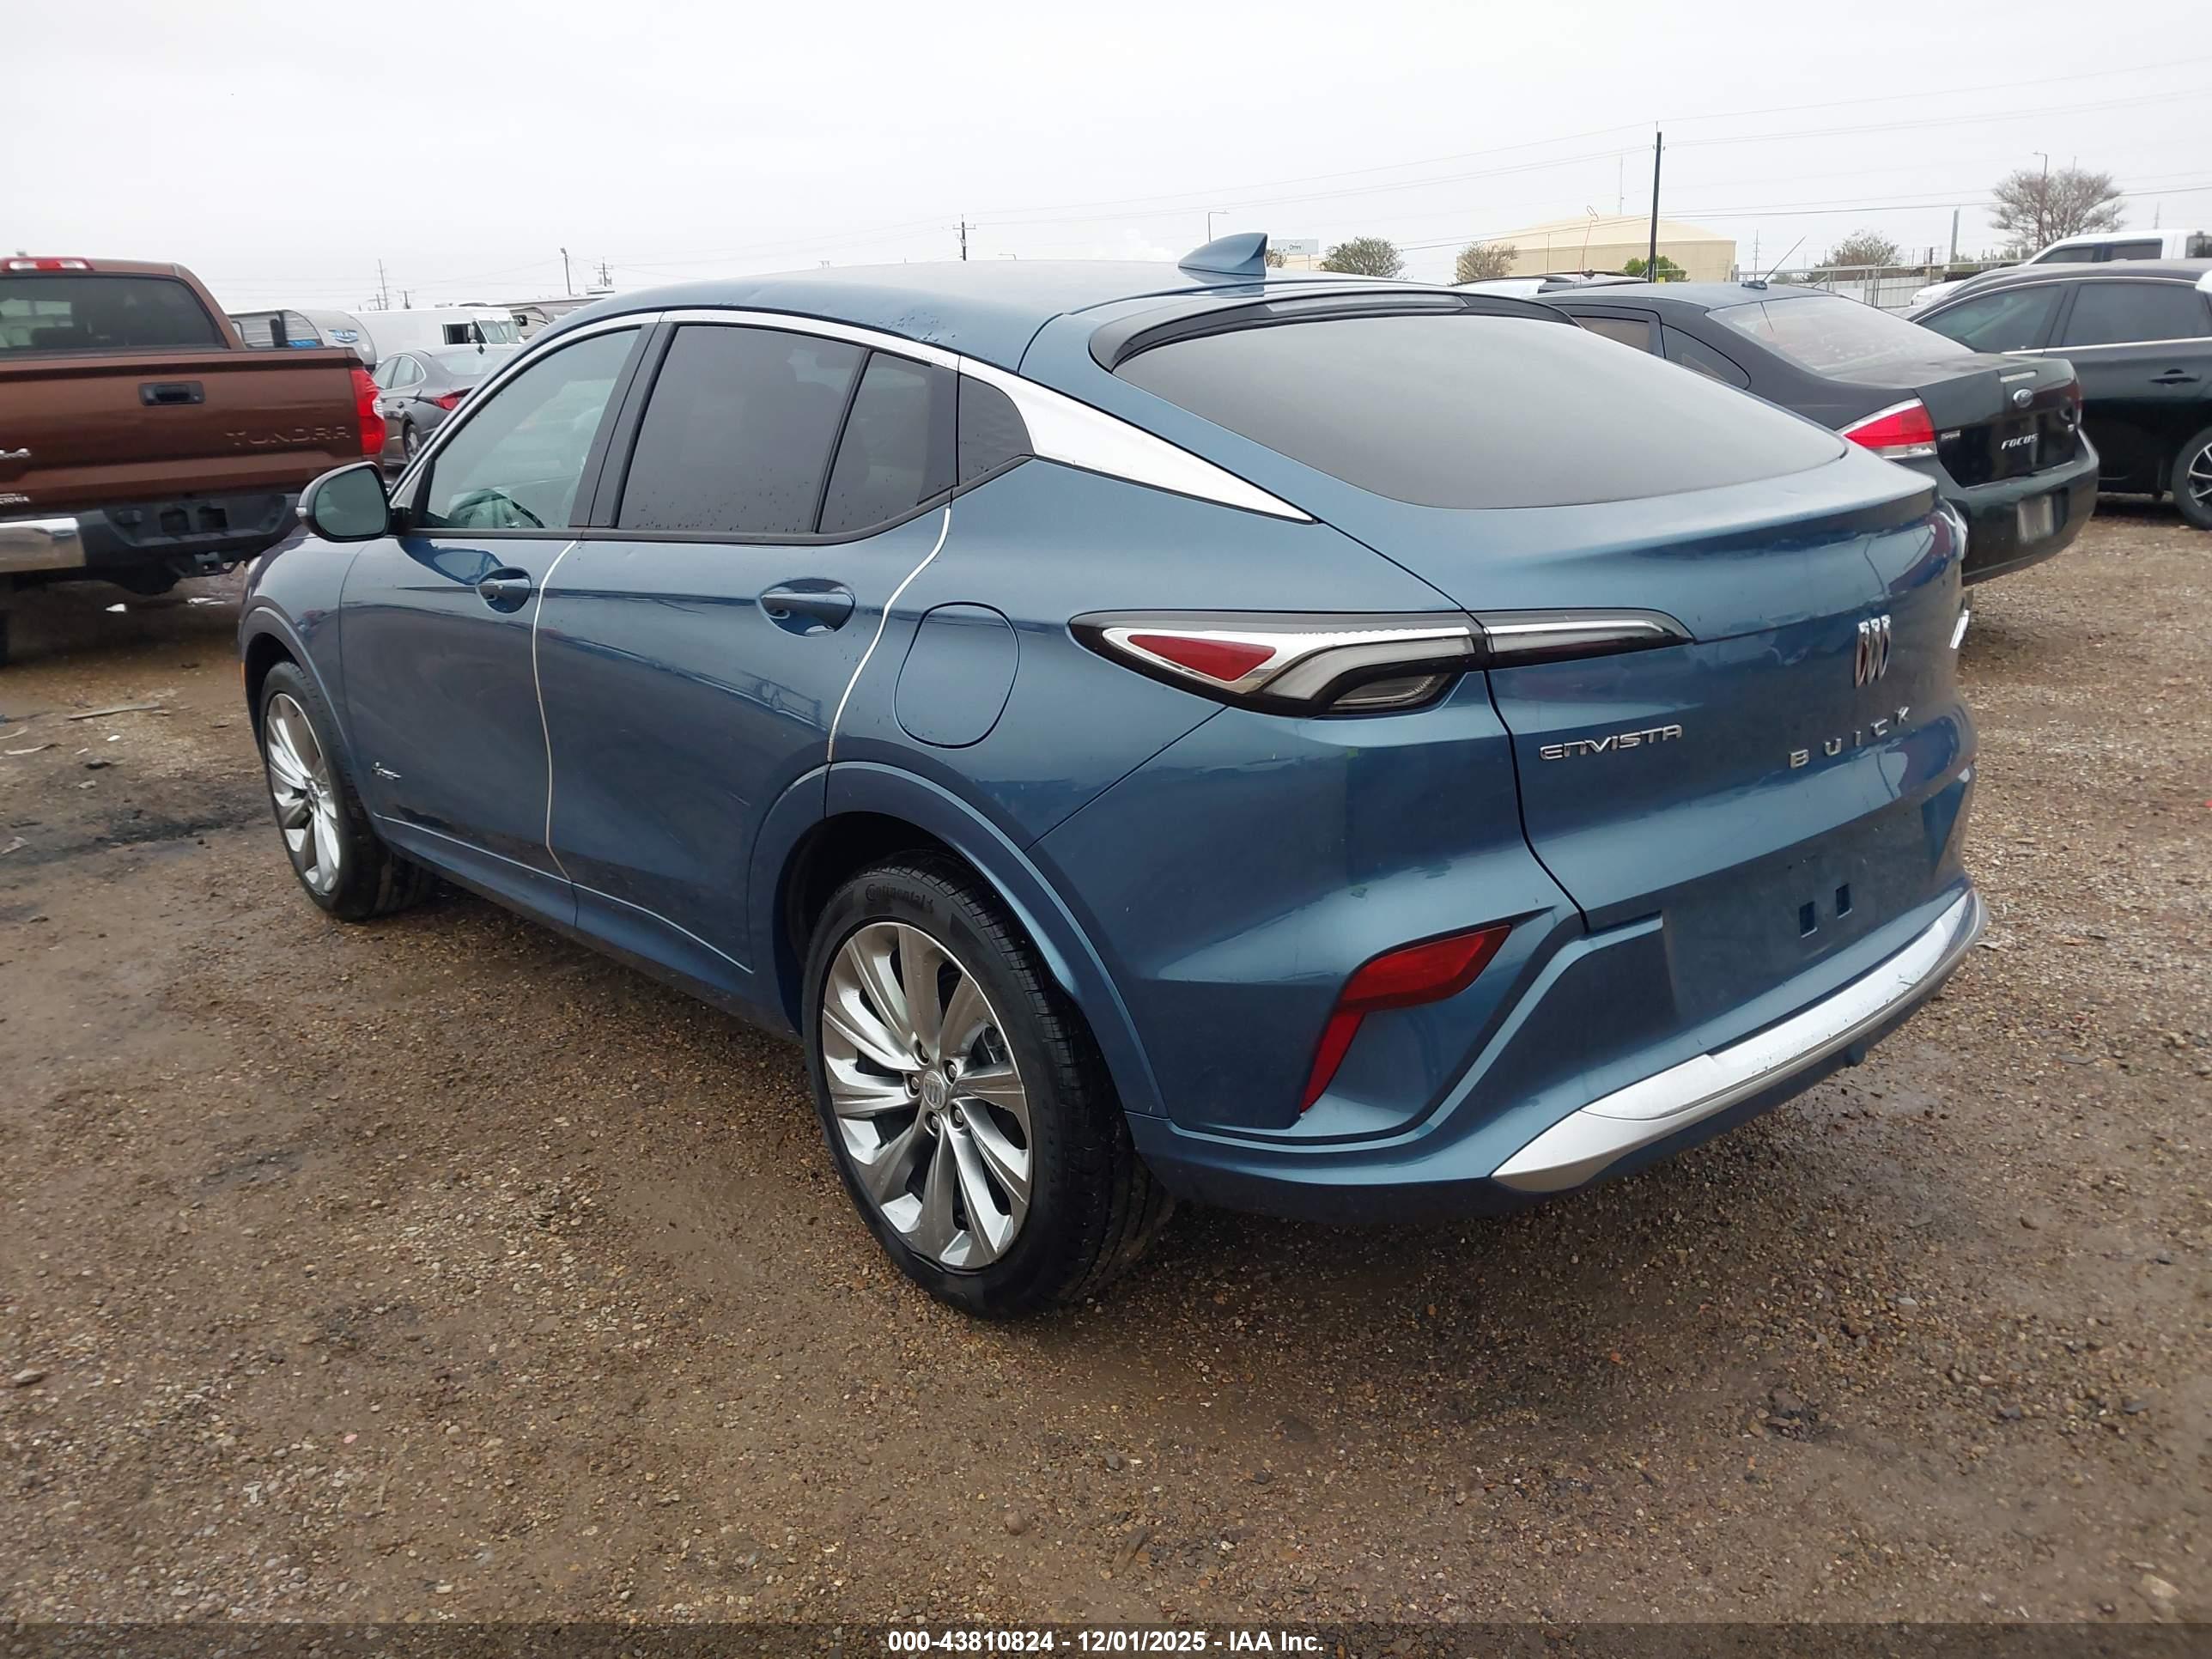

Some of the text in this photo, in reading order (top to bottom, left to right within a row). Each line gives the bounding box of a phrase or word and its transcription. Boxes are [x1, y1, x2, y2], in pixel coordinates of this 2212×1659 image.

[225, 426, 351, 446] TUNDRA
[2001, 433, 2039, 451] FOCUS
[1539, 724, 1682, 762] ENVISTA
[1789, 706, 1910, 769] BUICK
[865, 882, 927, 908] Continental
